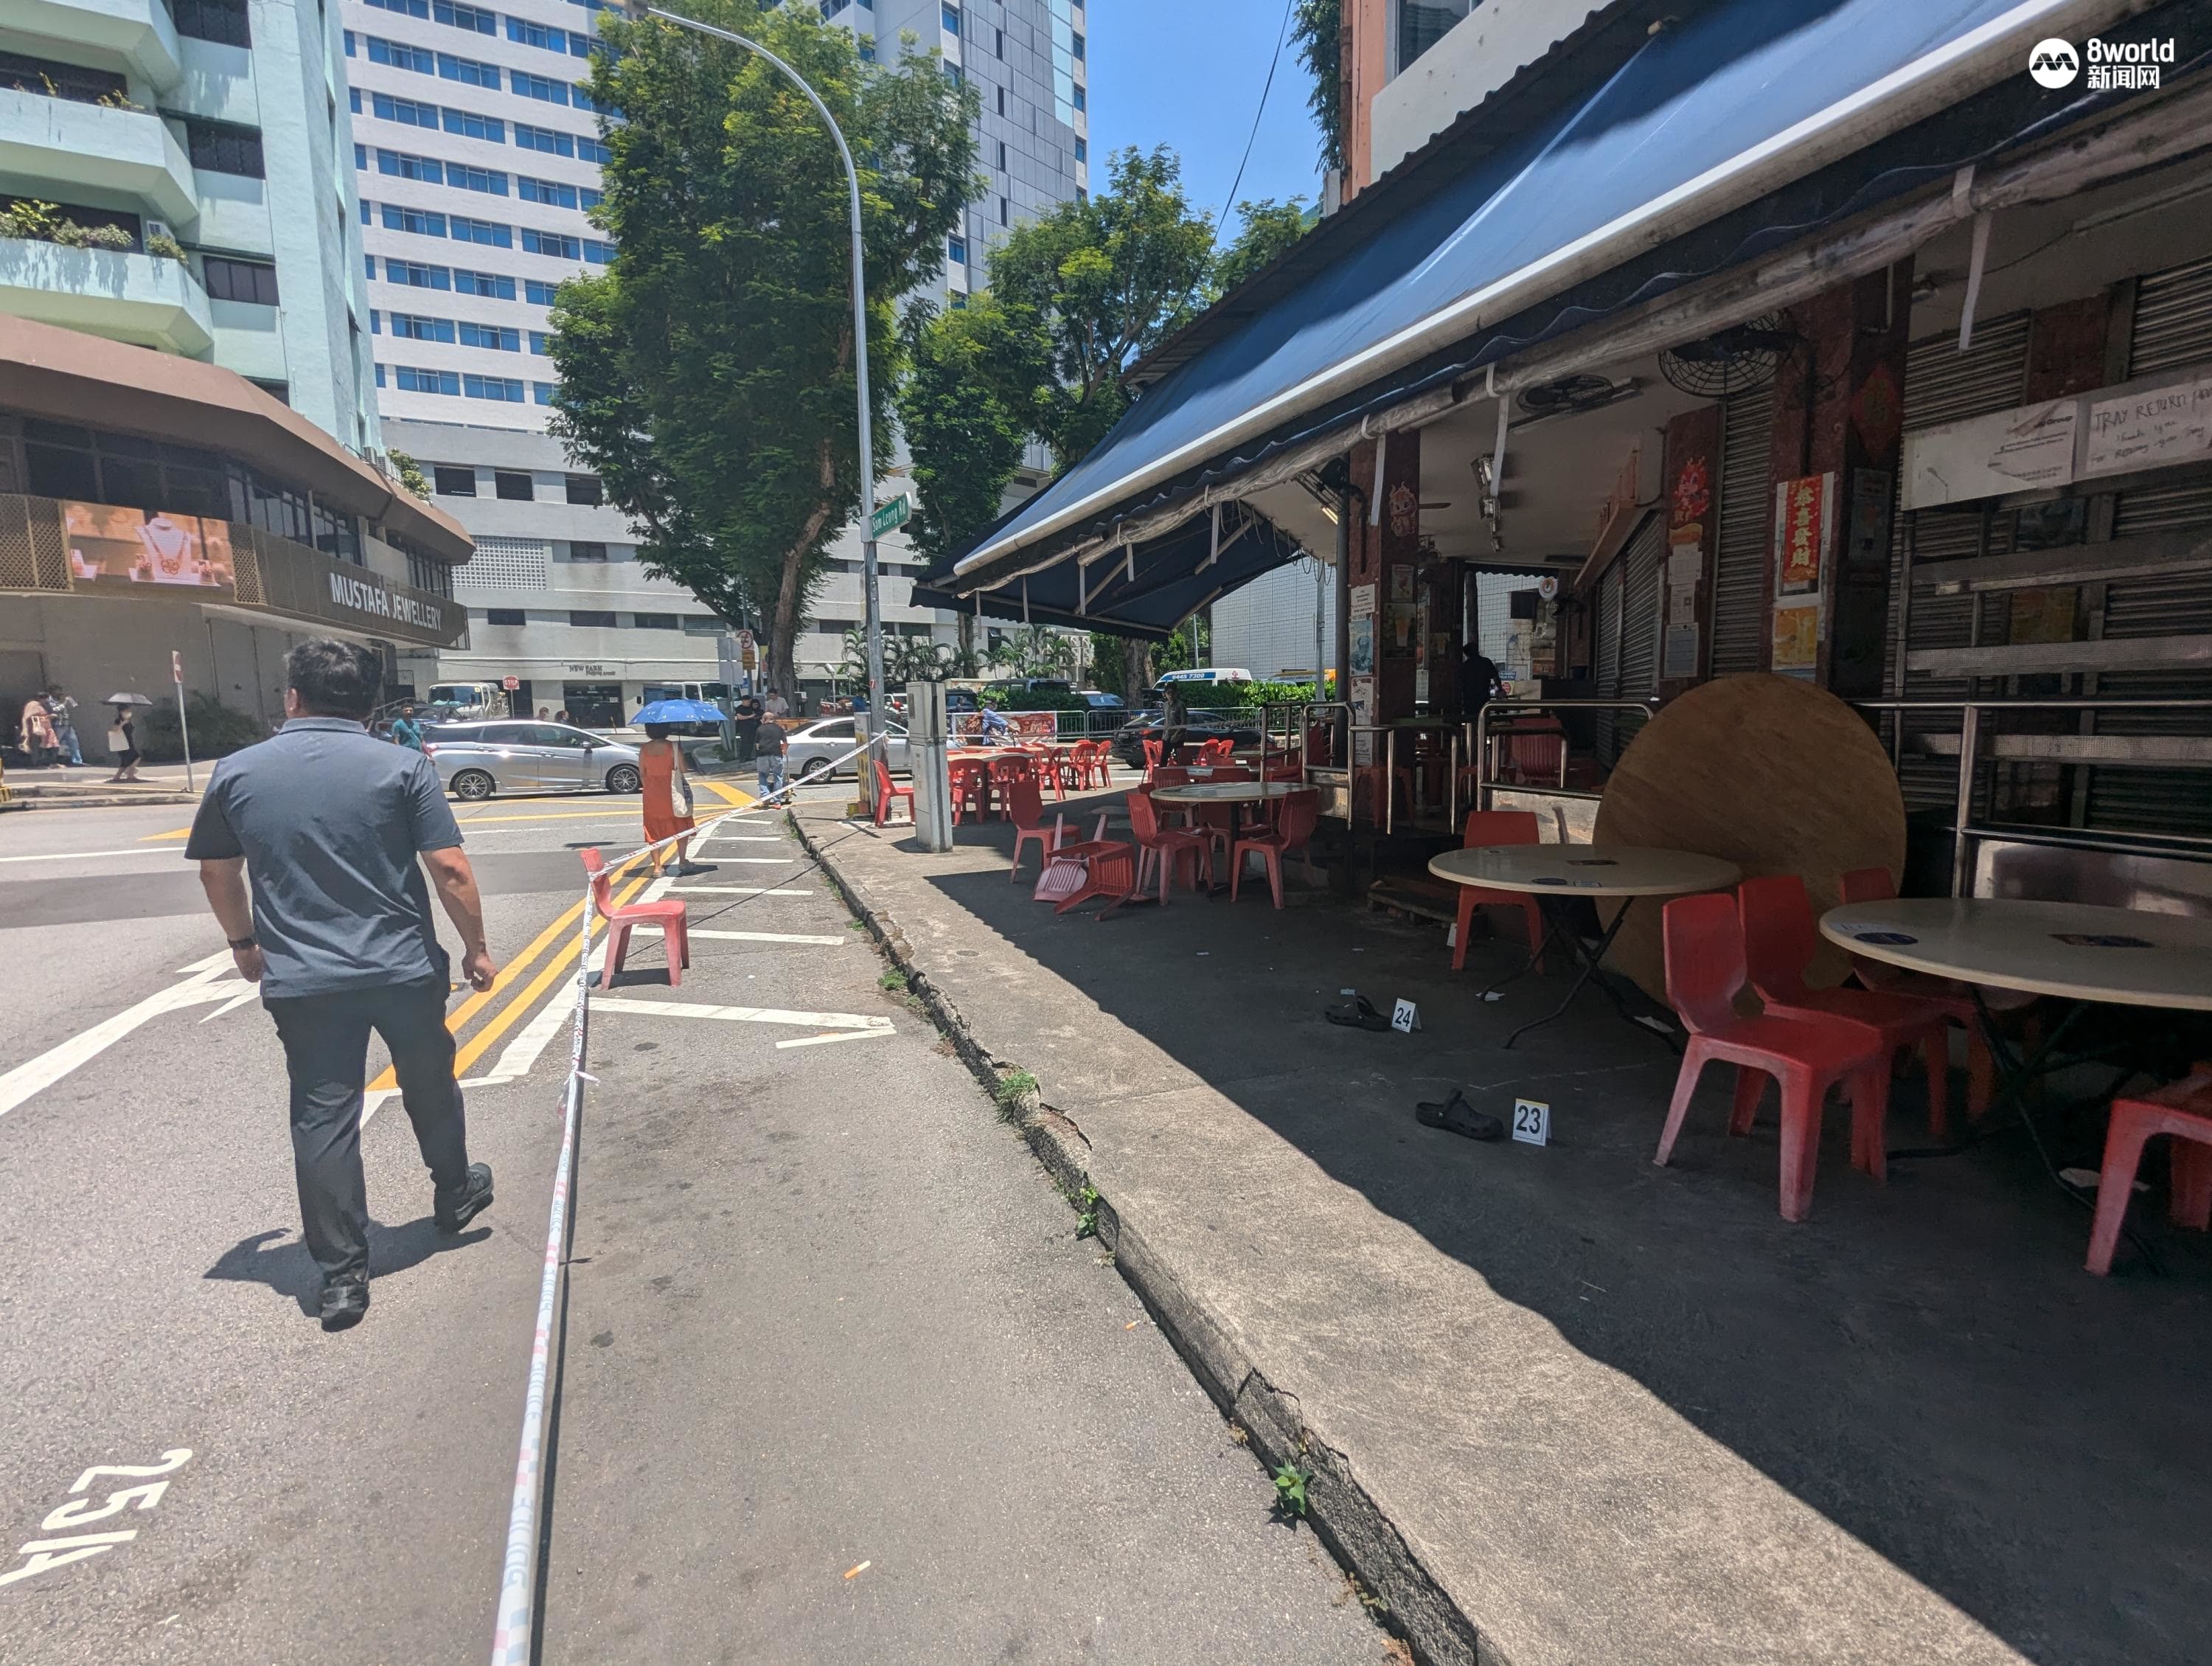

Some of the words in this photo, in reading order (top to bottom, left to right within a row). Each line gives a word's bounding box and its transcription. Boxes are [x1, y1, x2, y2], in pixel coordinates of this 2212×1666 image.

[2093, 410, 2128, 437] TRAY
[882, 508, 898, 527] Leong
[898, 498, 906, 516] Rd
[330, 572, 390, 617] MUSTAFA
[392, 593, 442, 631] JEWELLERY
[1395, 1007, 1411, 1027] 24
[1515, 1105, 1541, 1134] 23
